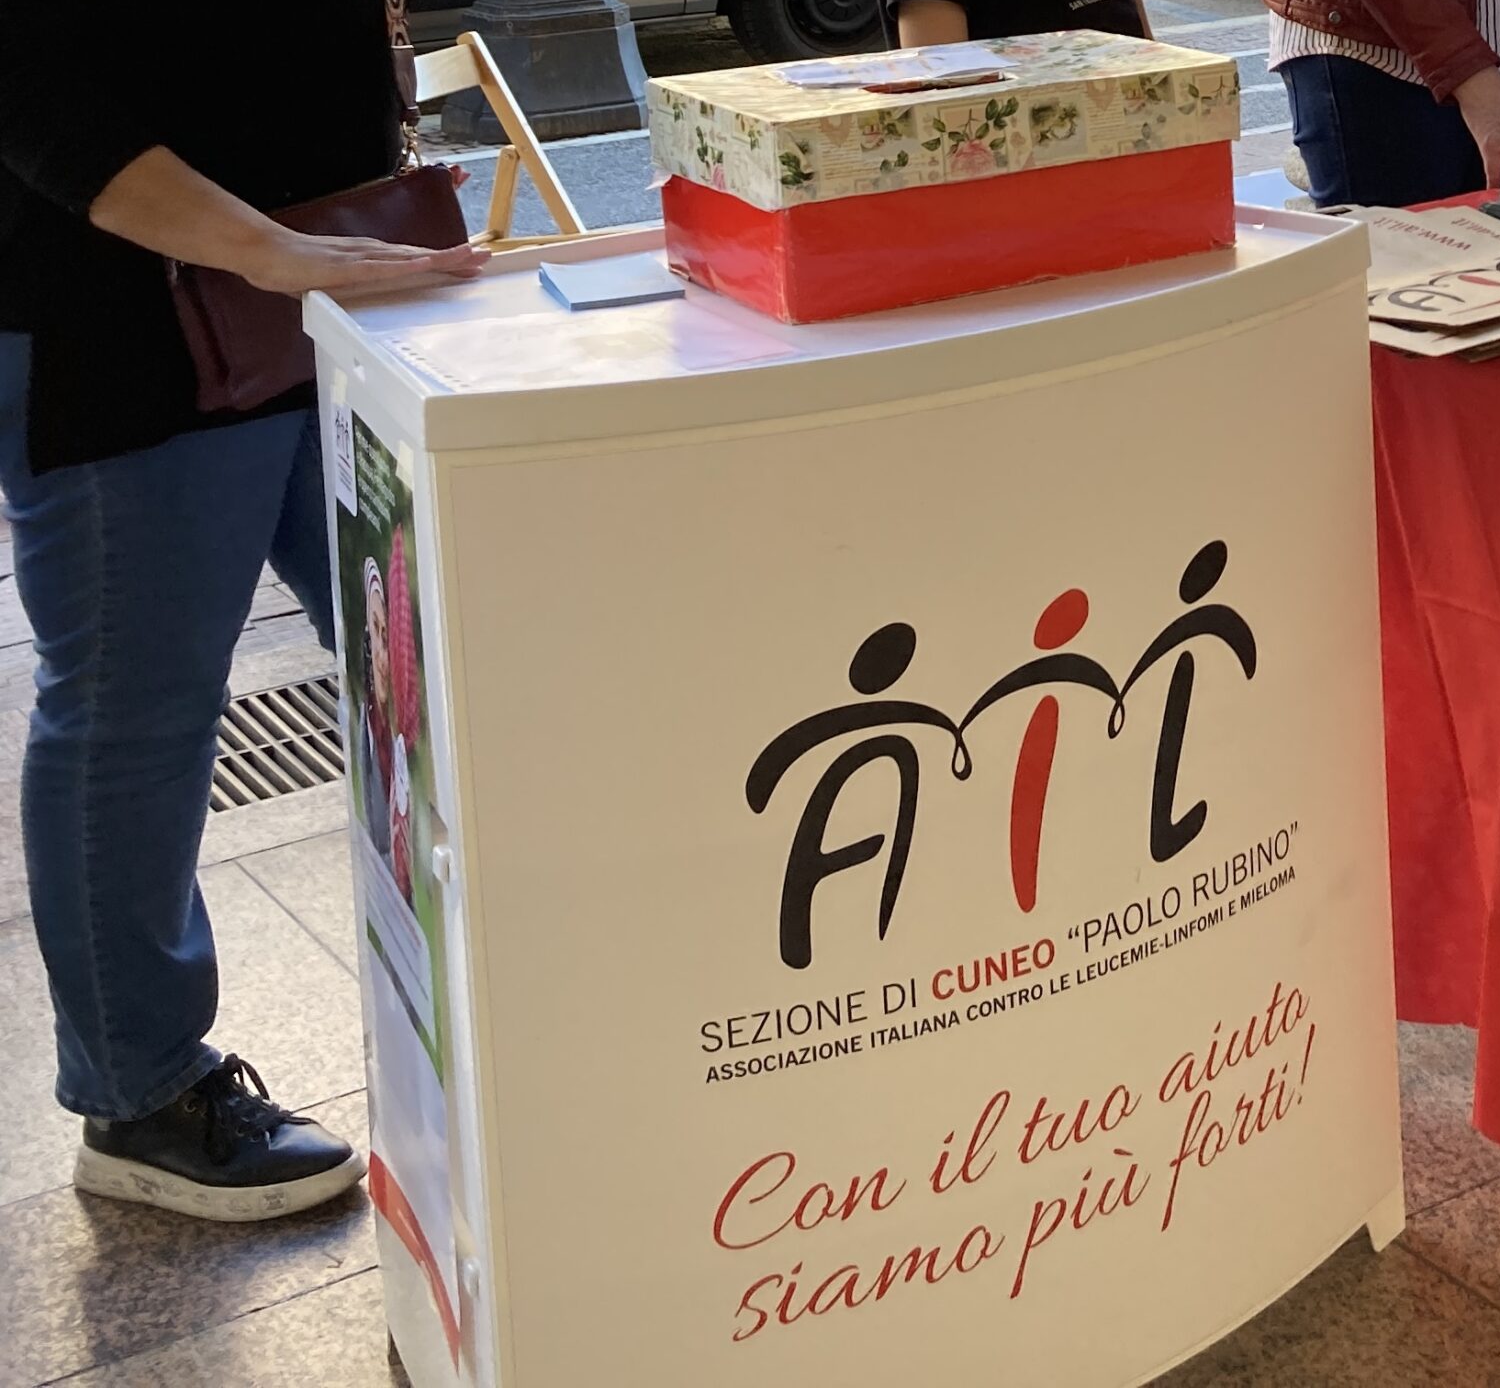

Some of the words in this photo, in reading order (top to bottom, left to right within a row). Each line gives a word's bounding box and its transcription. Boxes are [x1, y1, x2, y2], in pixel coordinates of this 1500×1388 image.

[746, 597, 1256, 969] AIL
[701, 988, 868, 1053] SEZIONE
[881, 978, 917, 1015] DI
[932, 938, 1055, 1000] CUNEO
[705, 1029, 863, 1084] ASSOCIAZIONE
[870, 1010, 960, 1050] ITALIANA
[966, 982, 1043, 1022] CONTRO
[1049, 971, 1071, 996] LE
[1076, 909, 1224, 986] LEUCEMIE-LINFOMI
[1228, 900, 1237, 917] E
[1240, 865, 1296, 912] MIELOMA
[713, 1151, 908, 1251] Con
[930, 1090, 1010, 1194] il
[1018, 1083, 1142, 1164] tuo
[1159, 981, 1311, 1103] aiuto
[732, 1224, 1006, 1343] siamo
[1010, 1148, 1150, 1300] più
[1161, 1023, 1316, 1233] forti!
